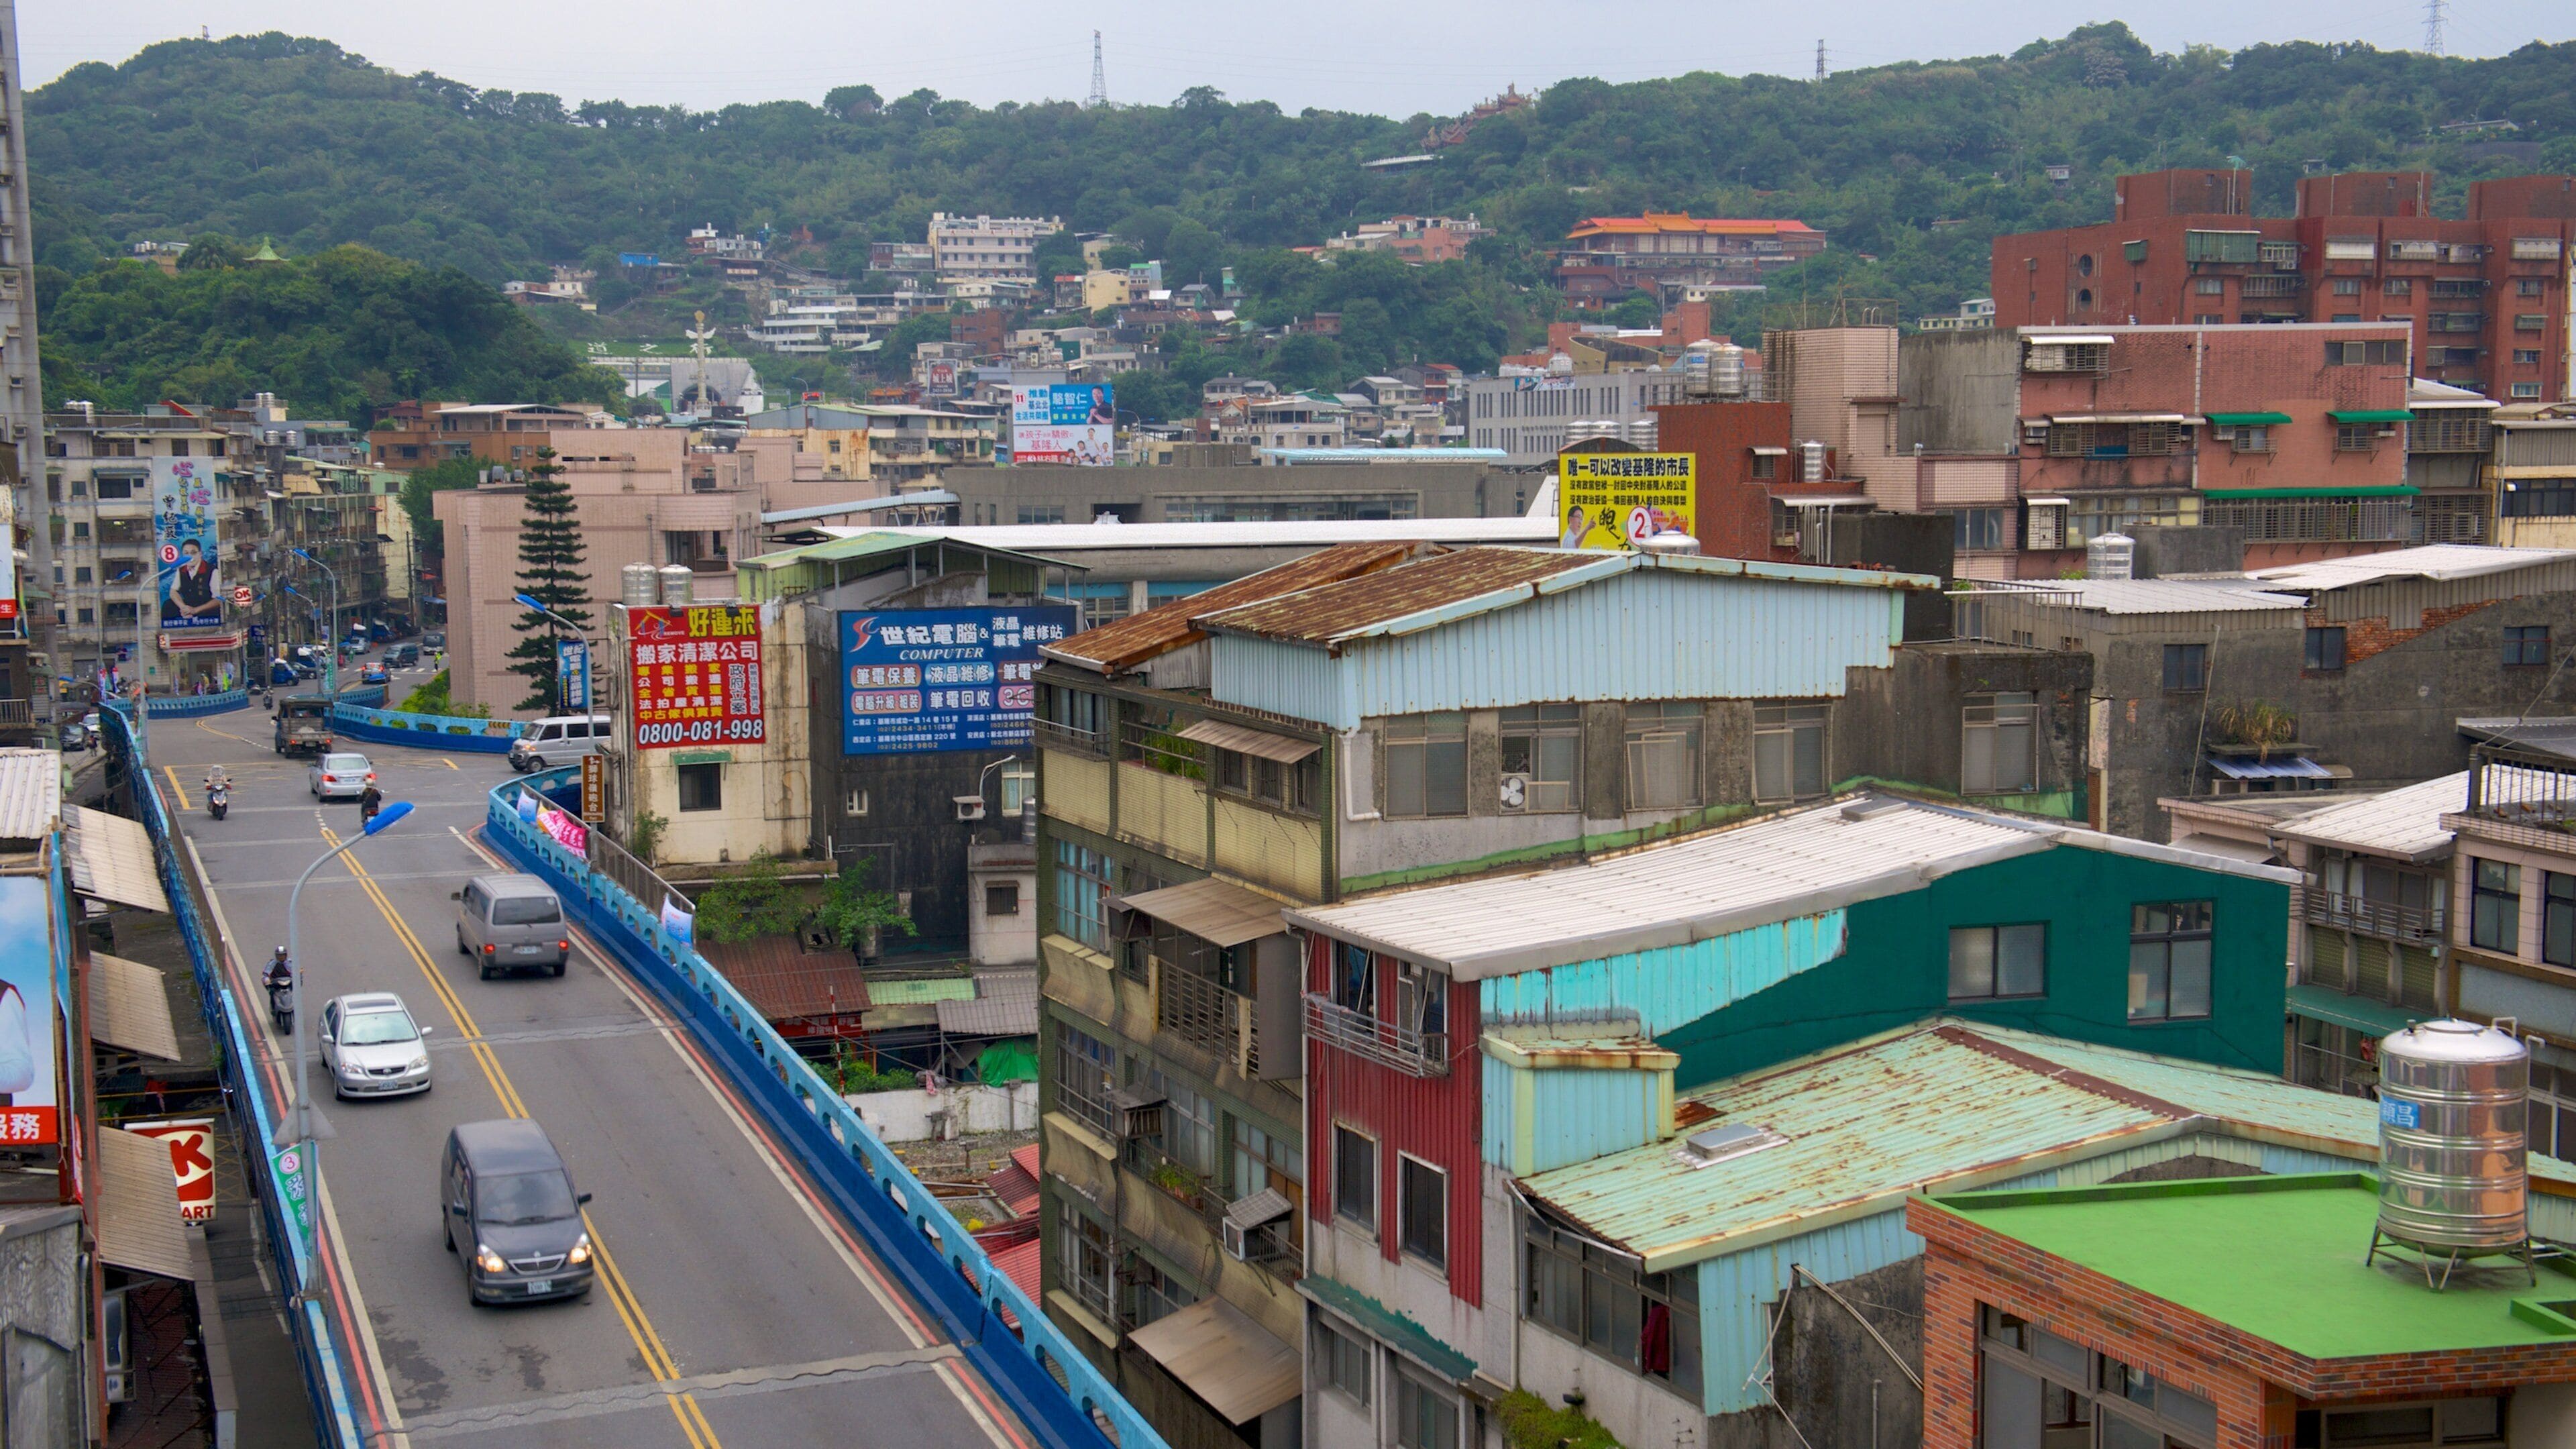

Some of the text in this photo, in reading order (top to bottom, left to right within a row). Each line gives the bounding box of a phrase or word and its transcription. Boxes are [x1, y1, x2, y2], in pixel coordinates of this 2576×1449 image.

[1016, 394, 1024, 402] 11
[1029, 388, 1048, 398] 推動
[1031, 439, 1063, 450] 基隆人
[1568, 457, 1689, 477] 唯一可以改變基隆的市長
[1634, 512, 1646, 539] 2
[164, 547, 175, 560] 8
[235, 589, 251, 599] OK
[688, 606, 756, 637] 好運來
[992, 616, 1020, 631] 液晶
[880, 624, 989, 645] 世紀電腦 &
[993, 633, 1020, 647] 筆電
[1022, 624, 1063, 641] 維修站
[637, 641, 758, 665] 搬家清潔公司
[900, 647, 984, 661] COMPUTER
[637, 663, 720, 677] 專業搬家
[856, 667, 916, 686] 筆電保養
[930, 663, 990, 683] 液晶維修
[729, 663, 747, 715] 政府立案
[929, 690, 990, 709] 筆電回收
[639, 718, 763, 745] 0800-081-998
[284, 1156, 295, 1170] 3
